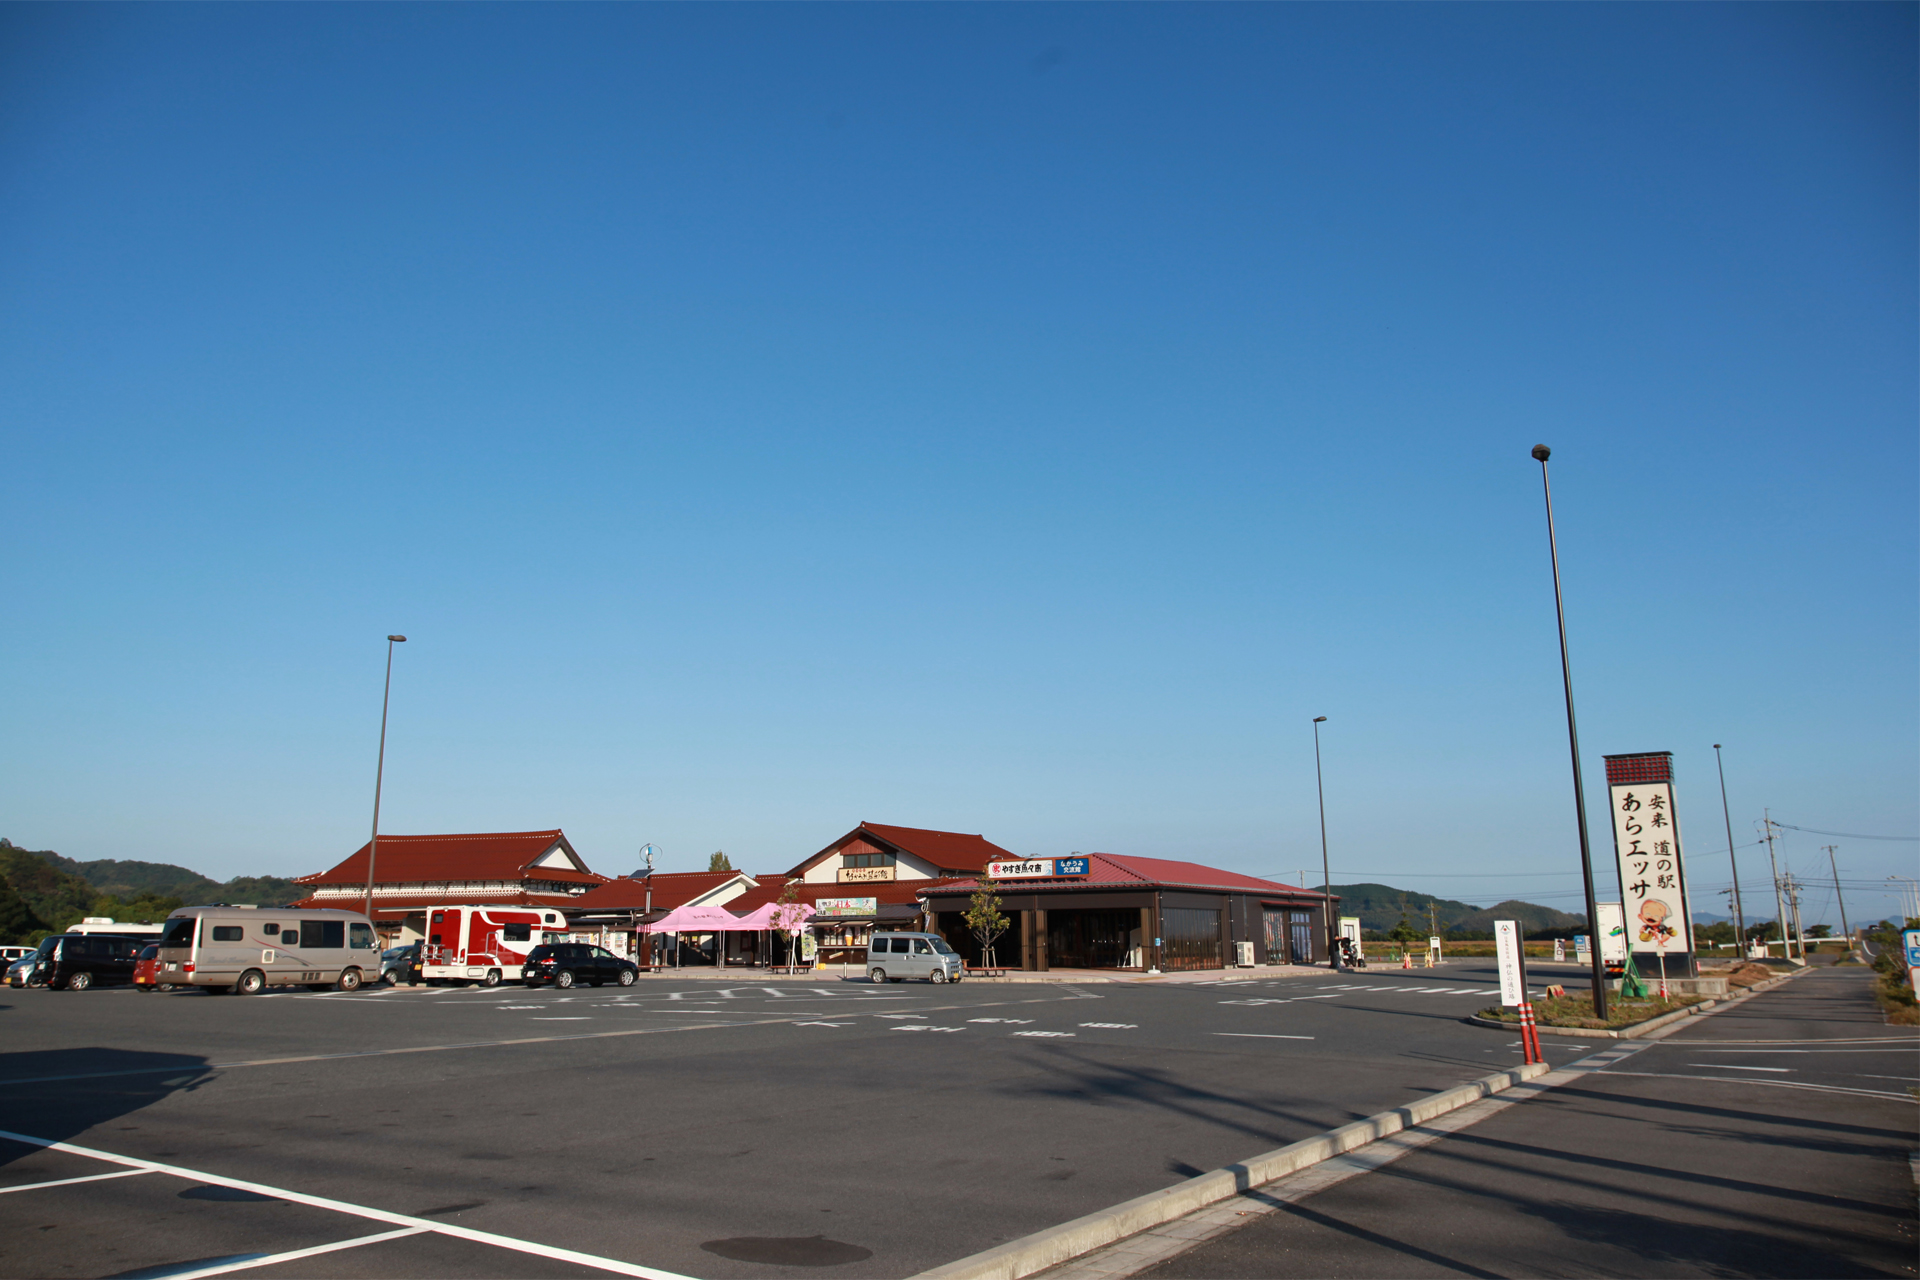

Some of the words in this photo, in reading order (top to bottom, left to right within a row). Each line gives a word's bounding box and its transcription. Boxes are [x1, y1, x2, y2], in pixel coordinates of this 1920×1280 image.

[1648, 794, 1669, 829] 安来
[1060, 860, 1084, 868] なかうみ
[1622, 792, 1651, 899] あらエッサ
[1653, 839, 1676, 889] 道の駅
